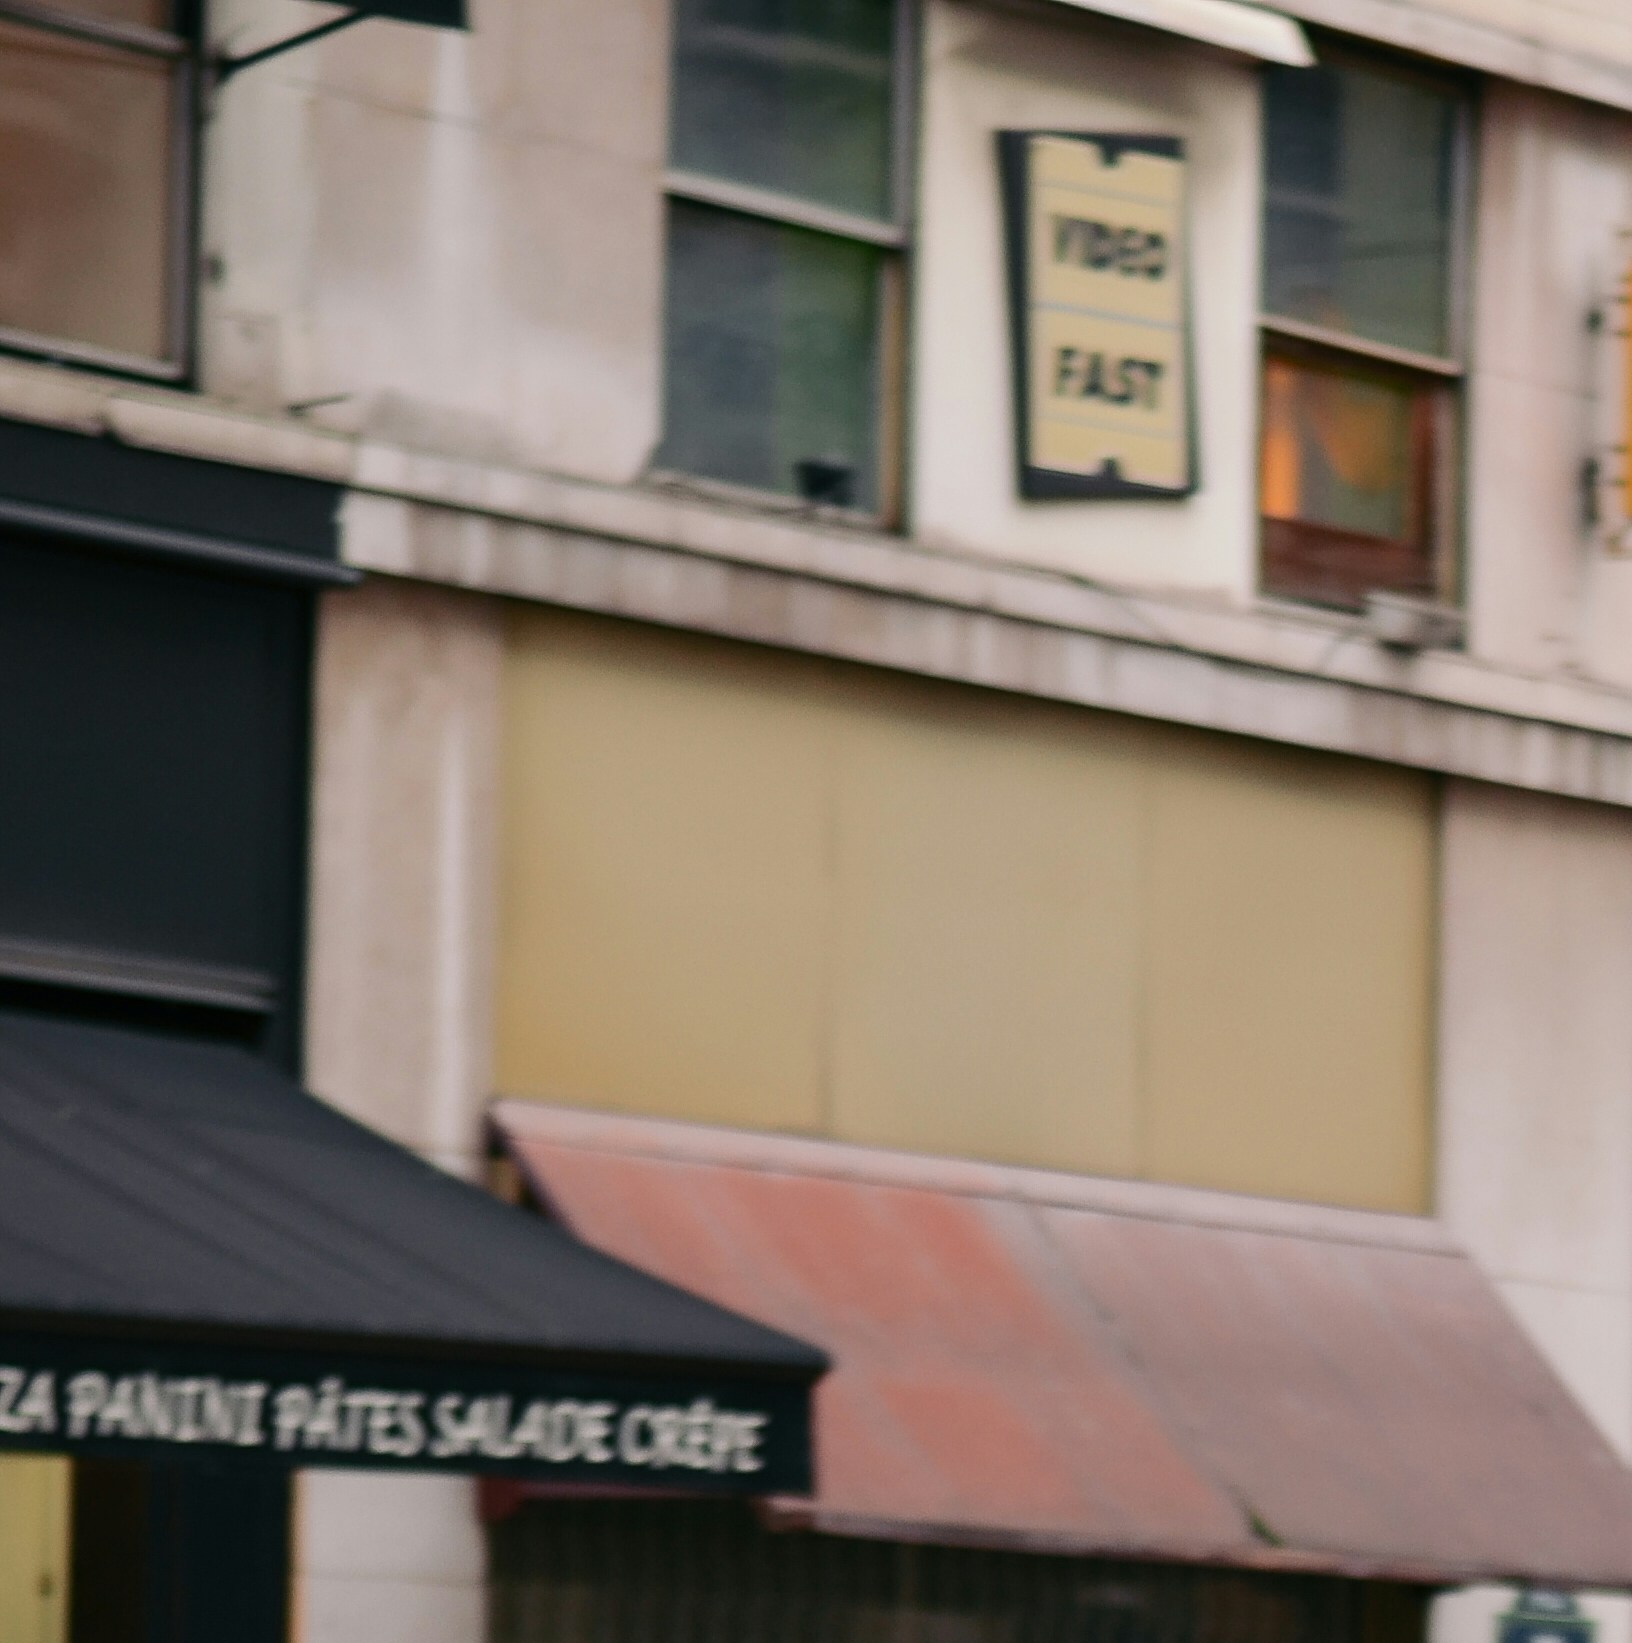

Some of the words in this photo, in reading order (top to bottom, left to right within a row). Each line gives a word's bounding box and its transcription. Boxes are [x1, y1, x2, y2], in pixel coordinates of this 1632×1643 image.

[1050, 212, 1168, 281] VIDEO
[1054, 347, 1166, 410] FAST
[65, 1371, 268, 1446] PANINI
[429, 1393, 616, 1463] SALADE
